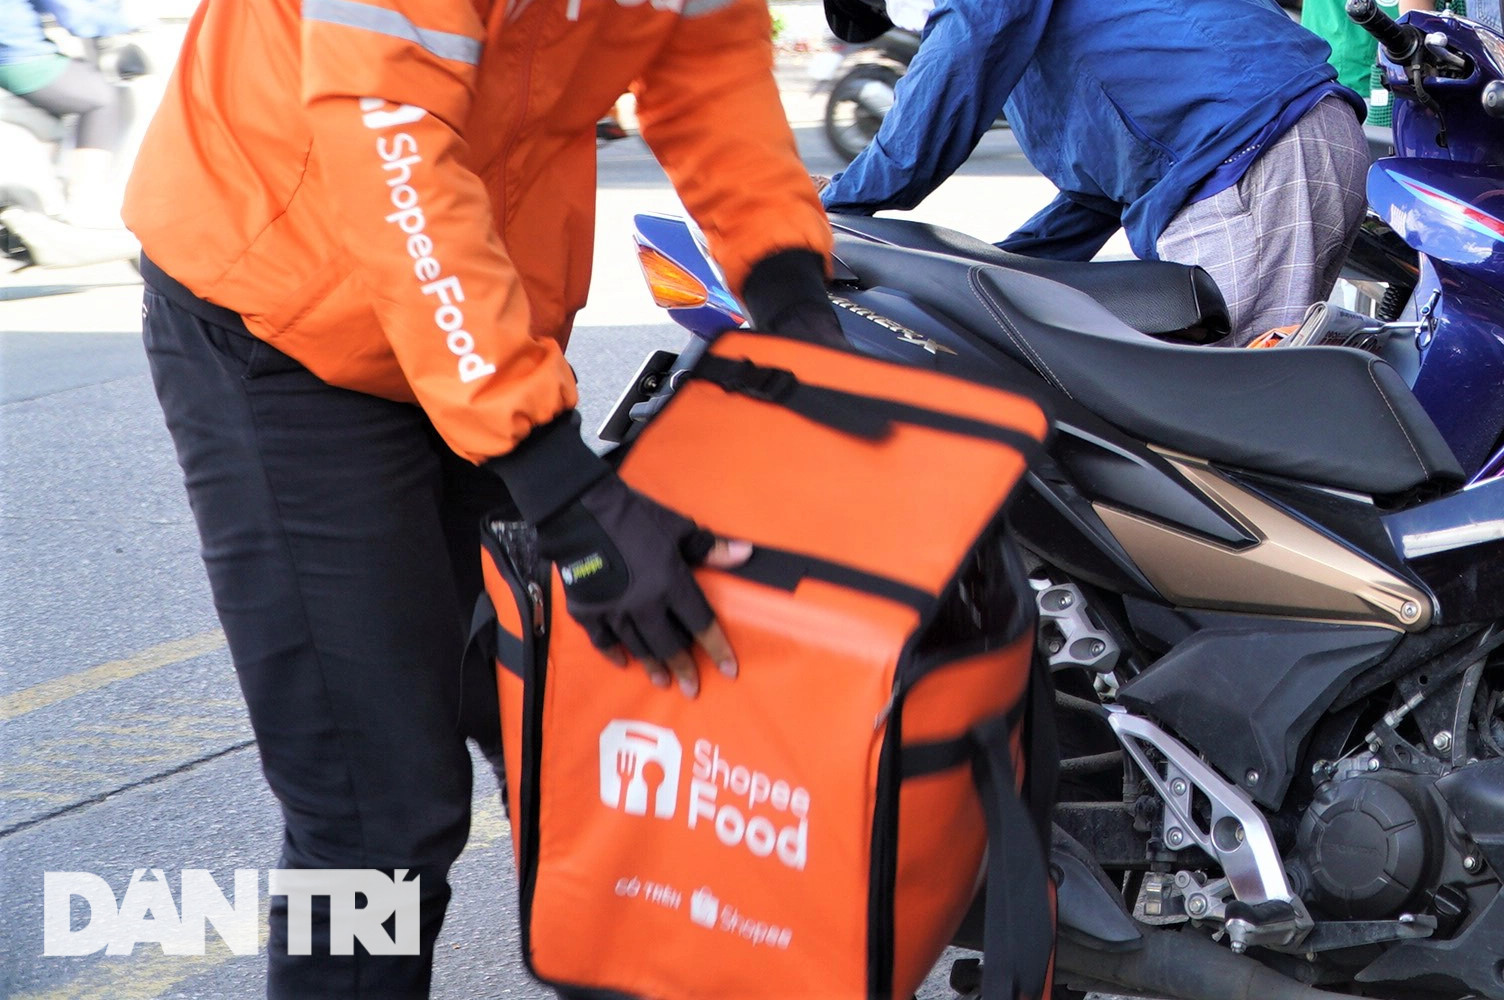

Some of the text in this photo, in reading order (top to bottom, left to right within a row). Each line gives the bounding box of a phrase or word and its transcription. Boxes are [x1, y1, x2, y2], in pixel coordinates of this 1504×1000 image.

[376, 131, 496, 385] ShopeeFood
[693, 738, 811, 818] Shopee
[688, 779, 808, 872] Food
[720, 903, 793, 951] Shopee
